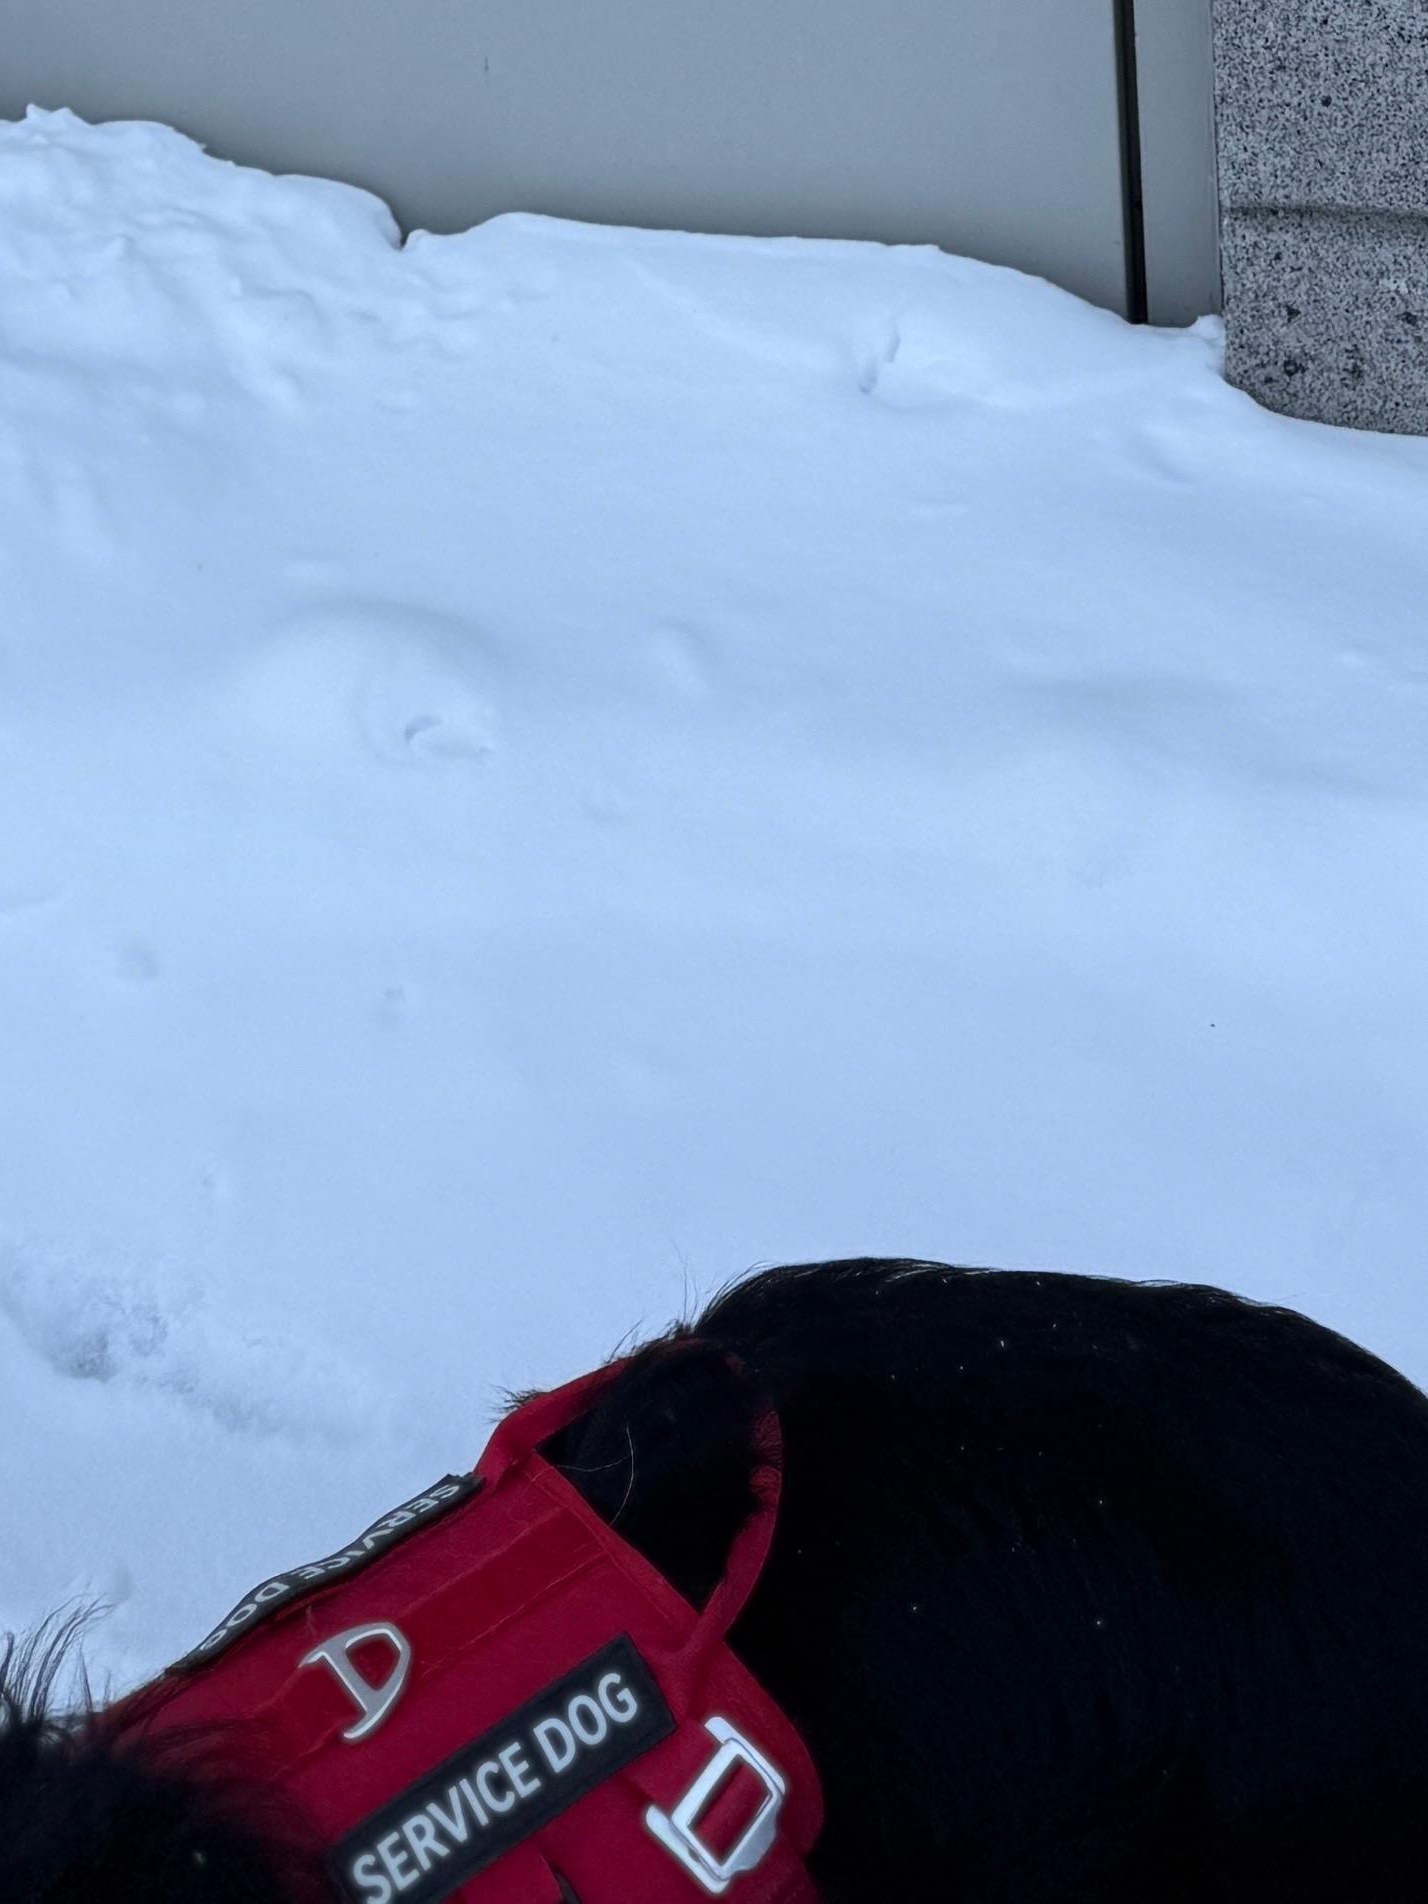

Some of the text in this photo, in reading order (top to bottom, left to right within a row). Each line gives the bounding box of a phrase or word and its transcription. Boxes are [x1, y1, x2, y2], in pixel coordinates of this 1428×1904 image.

[293, 1484, 461, 1580] SERVICE
[352, 1672, 639, 1904] SERVICE DOG
